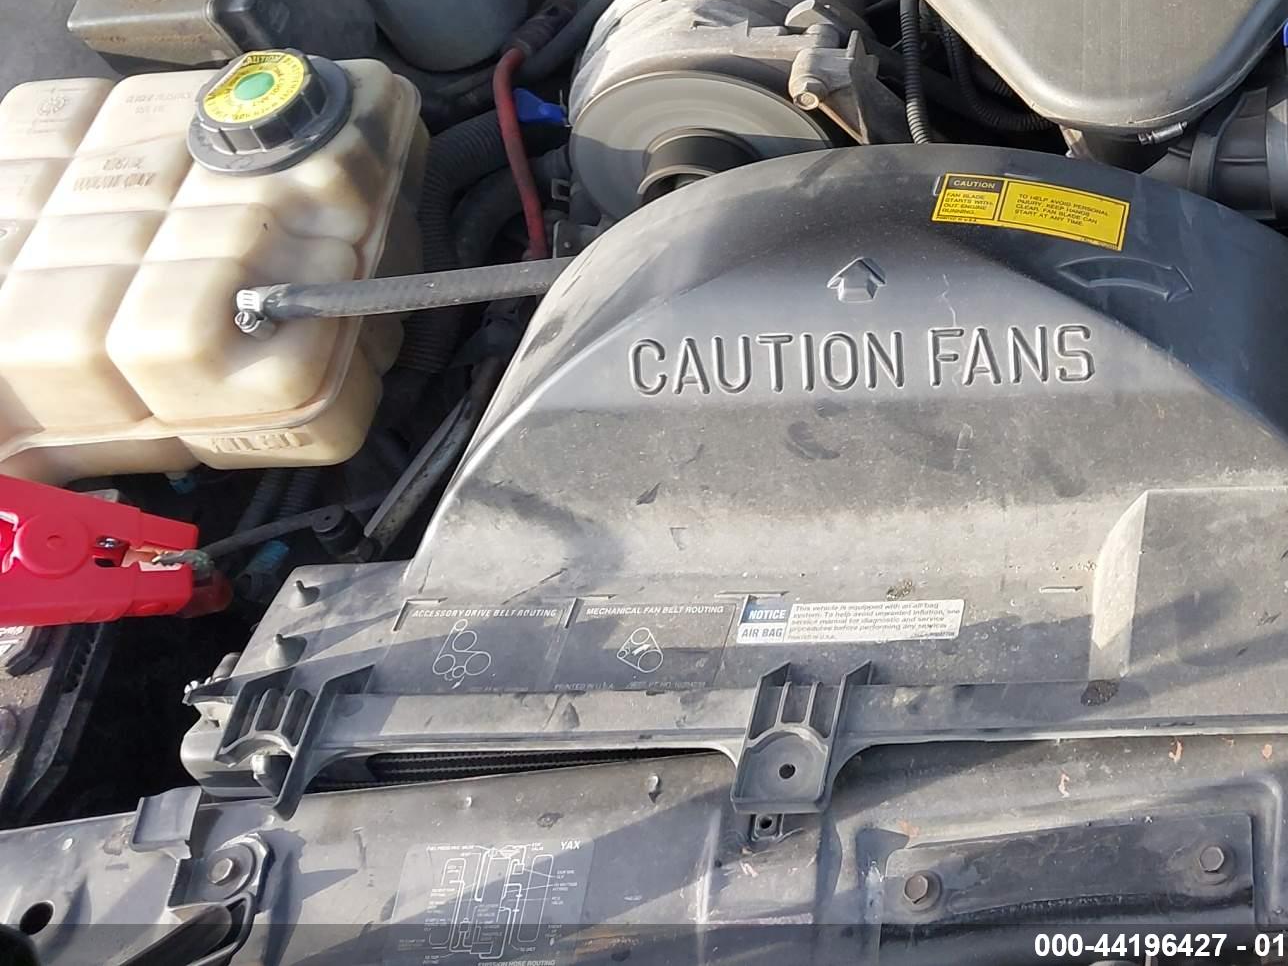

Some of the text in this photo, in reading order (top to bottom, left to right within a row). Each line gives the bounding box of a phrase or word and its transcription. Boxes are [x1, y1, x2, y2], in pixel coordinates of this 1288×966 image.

[953, 179, 996, 189] CAUTION
[1014, 209, 1037, 217] START
[1046, 204, 1065, 212] KEEP
[1066, 208, 1090, 217] HANDS
[1050, 199, 1072, 207] AVOID
[1073, 203, 1108, 216] PERSONAL
[1058, 211, 1081, 221] BLADE
[1083, 216, 1098, 224] CAN
[627, 323, 1098, 398] CAUTION FANS
[585, 605, 724, 616] MECHANICAL FAN BELT ROUTING
[848, 604, 883, 612] equipped
[924, 602, 939, 610] bag
[411, 608, 558, 618] ACCESSORY DRIVE BELT ROUTING
[748, 609, 787, 620] NOTICE
[836, 611, 851, 620] help
[861, 617, 900, 625] diagnostic
[741, 627, 783, 638] AIR BAG
[789, 625, 832, 633] procedures
[859, 624, 901, 632] performing
[560, 840, 581, 851] YAX
